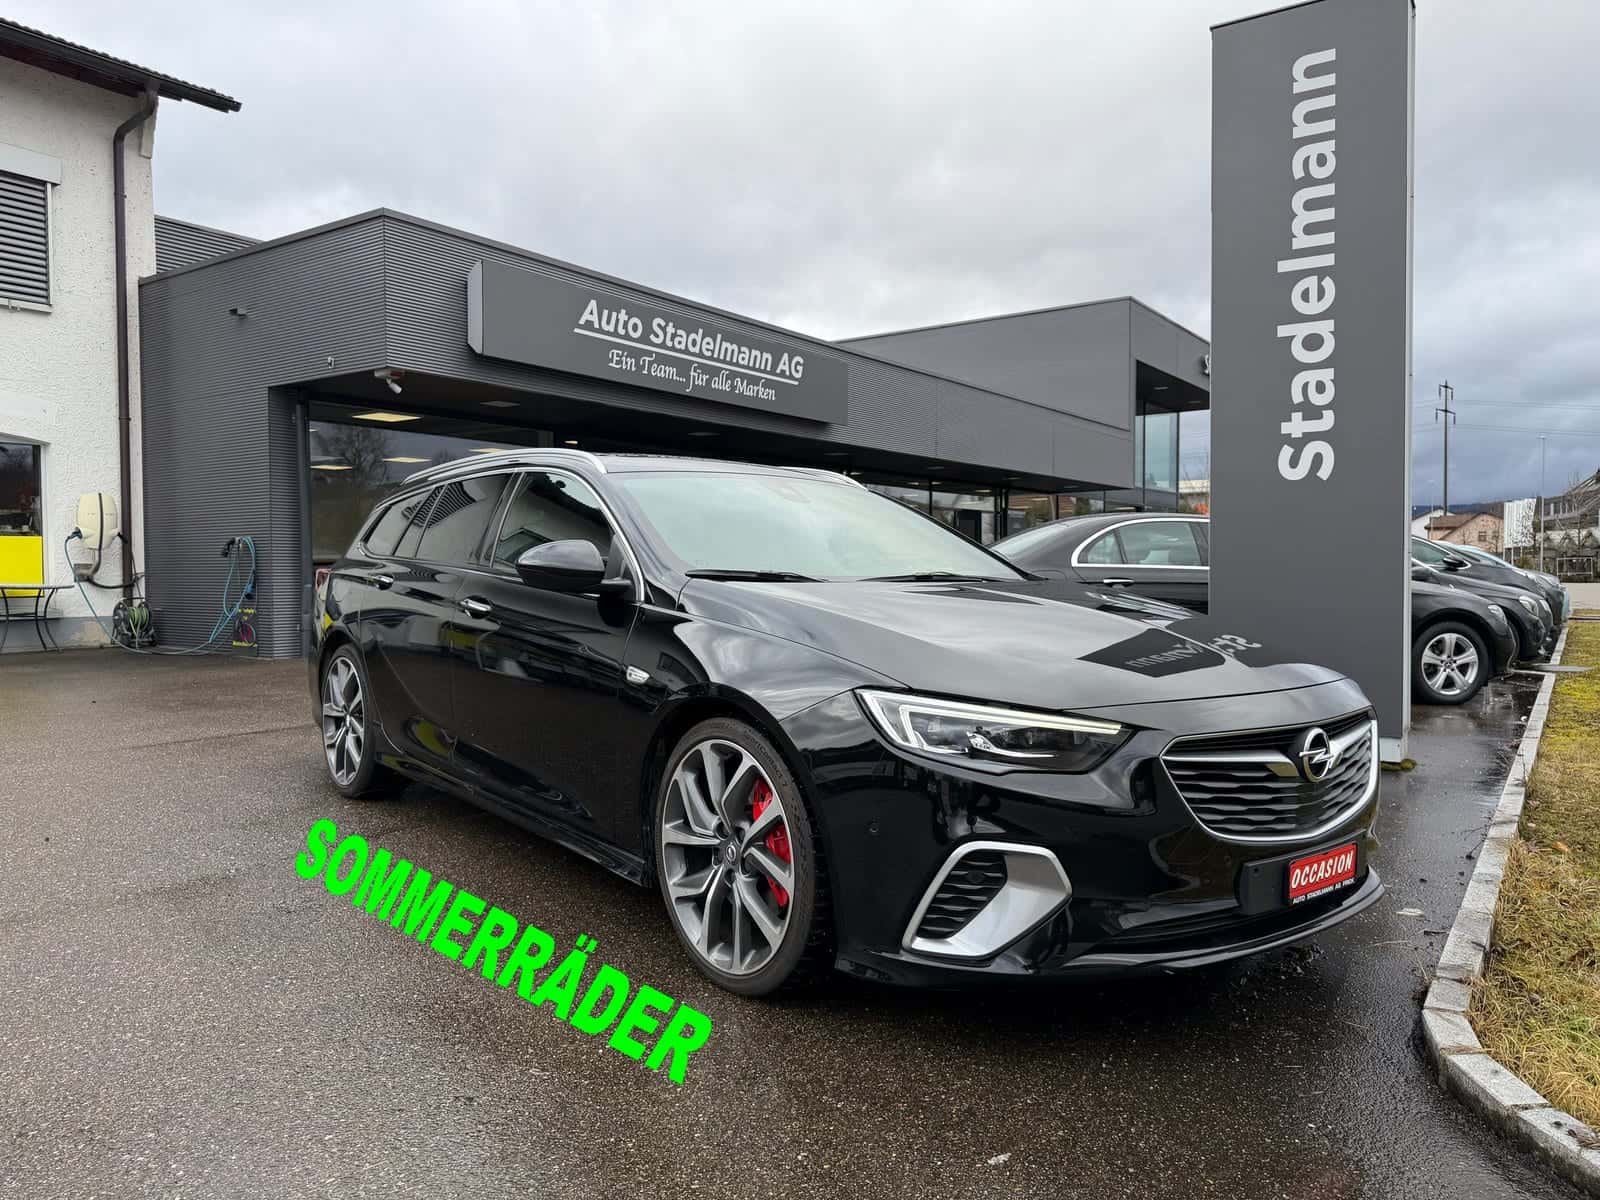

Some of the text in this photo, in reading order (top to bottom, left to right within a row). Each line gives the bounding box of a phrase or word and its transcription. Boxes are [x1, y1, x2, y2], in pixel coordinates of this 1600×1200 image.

[1277, 48, 1337, 481] Stadelmann
[579, 299, 804, 379] Auto Stadelmann AG
[608, 350, 776, 400] Ein Team... für alle Marken
[1291, 850, 1354, 889] OCCASION
